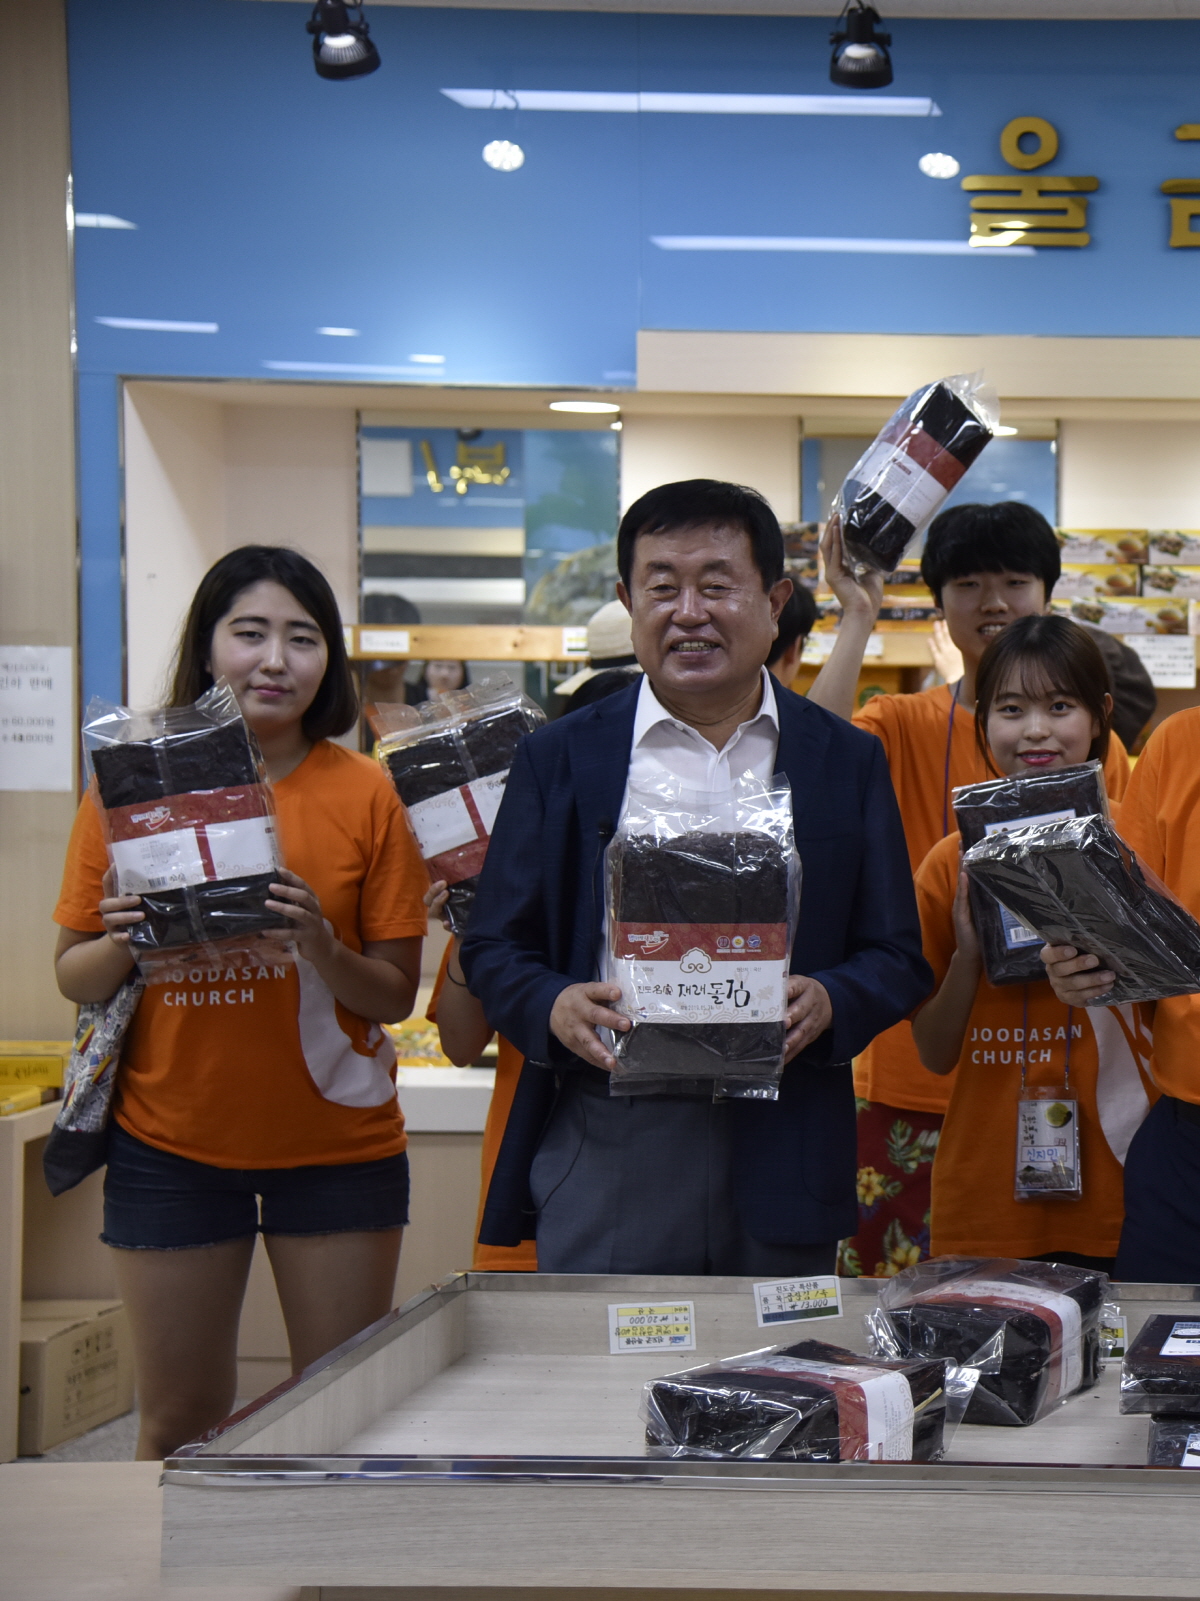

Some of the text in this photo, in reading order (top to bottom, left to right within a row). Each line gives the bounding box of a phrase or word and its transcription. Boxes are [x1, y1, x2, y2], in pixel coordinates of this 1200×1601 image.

[163, 987, 254, 1006] CHURCH
[677, 979, 751, 1008] 재래돌김
[970, 1024, 1082, 1042] JOODASAN
[971, 1048, 1052, 1065] CHURCH
